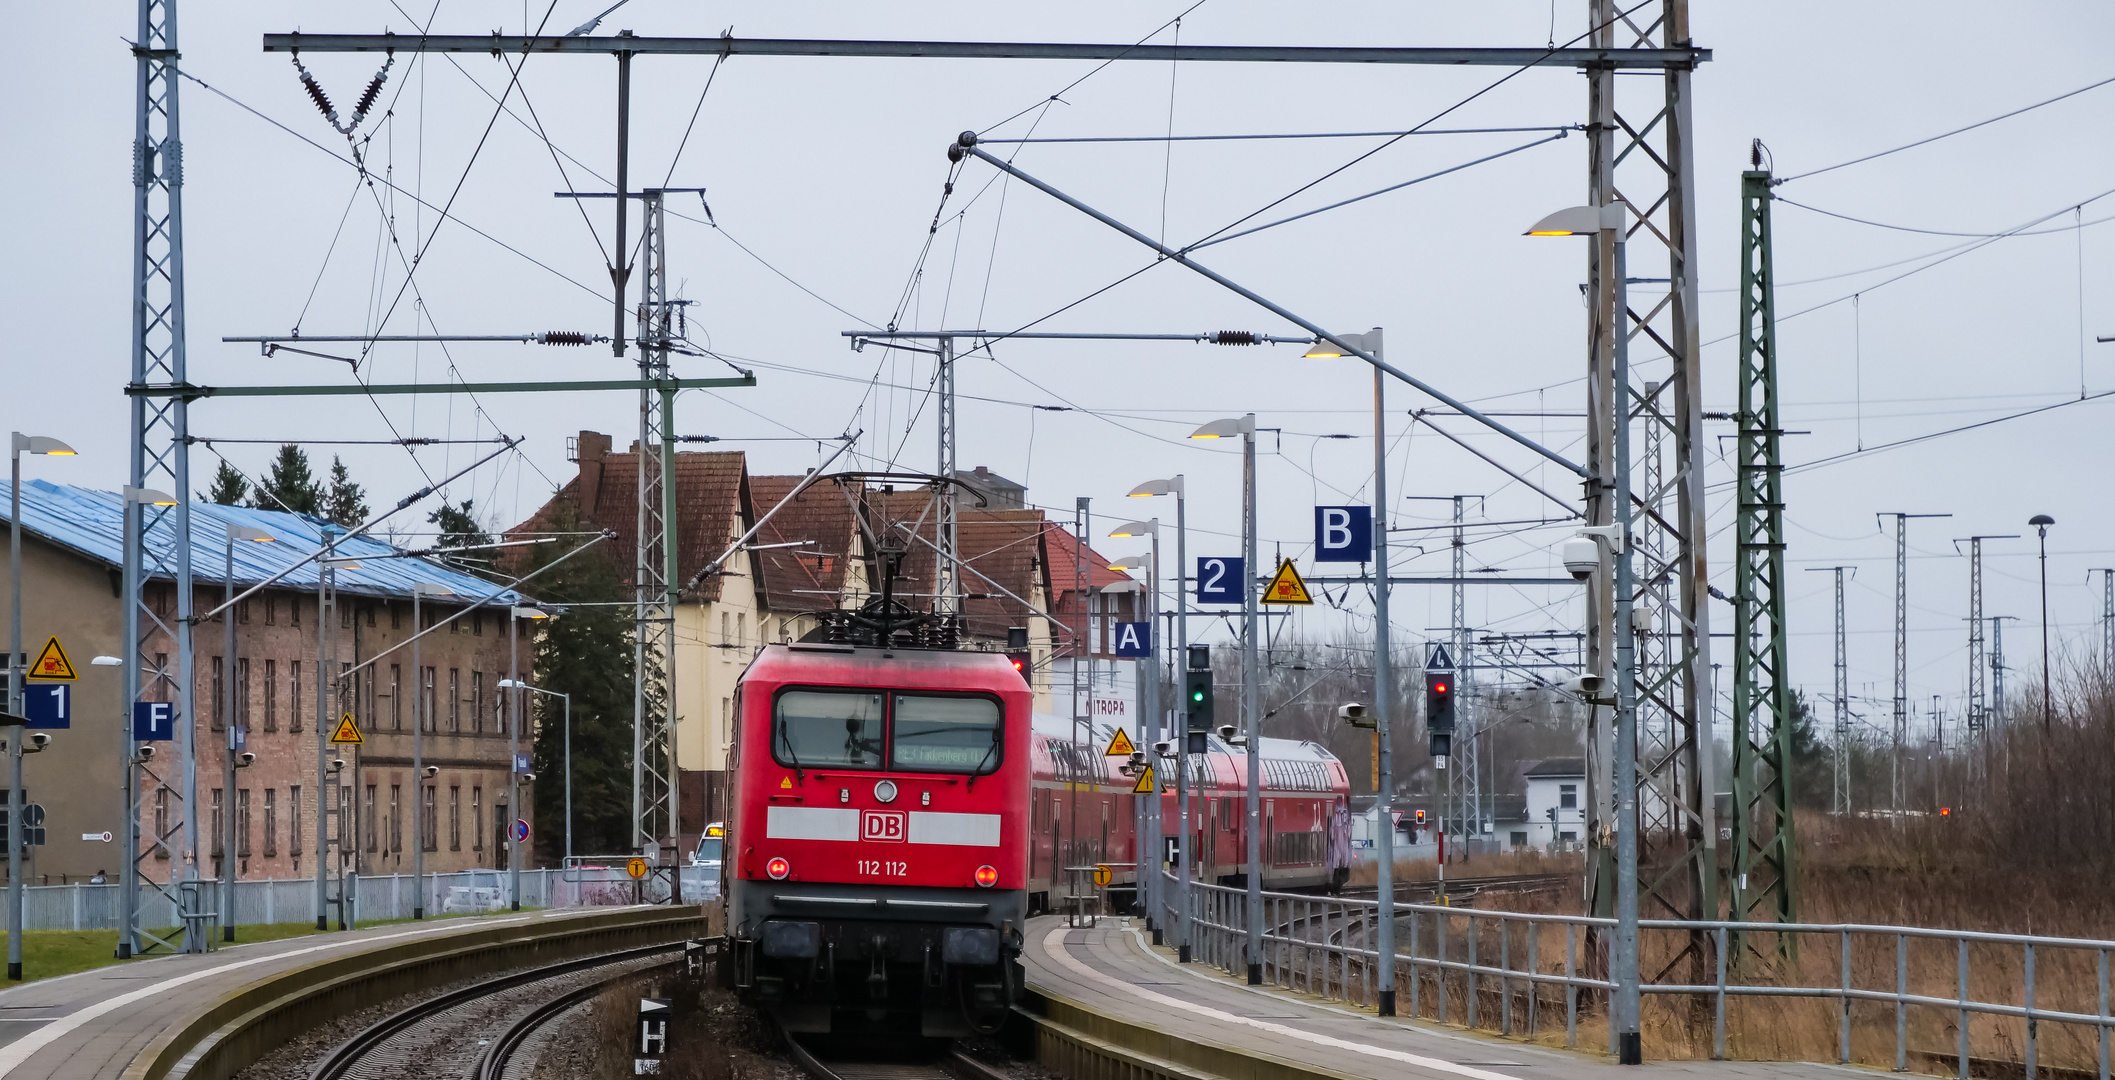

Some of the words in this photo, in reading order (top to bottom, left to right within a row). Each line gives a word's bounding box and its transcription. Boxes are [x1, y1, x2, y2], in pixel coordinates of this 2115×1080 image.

[1323, 508, 1352, 549] B
[1203, 559, 1226, 593] 2
[1119, 623, 1141, 650] A
[50, 685, 65, 719] 1
[150, 703, 169, 732] F
[867, 815, 901, 837] DB
[857, 860, 880, 875] 112
[885, 861, 907, 876] 112
[642, 1020, 666, 1054] H
